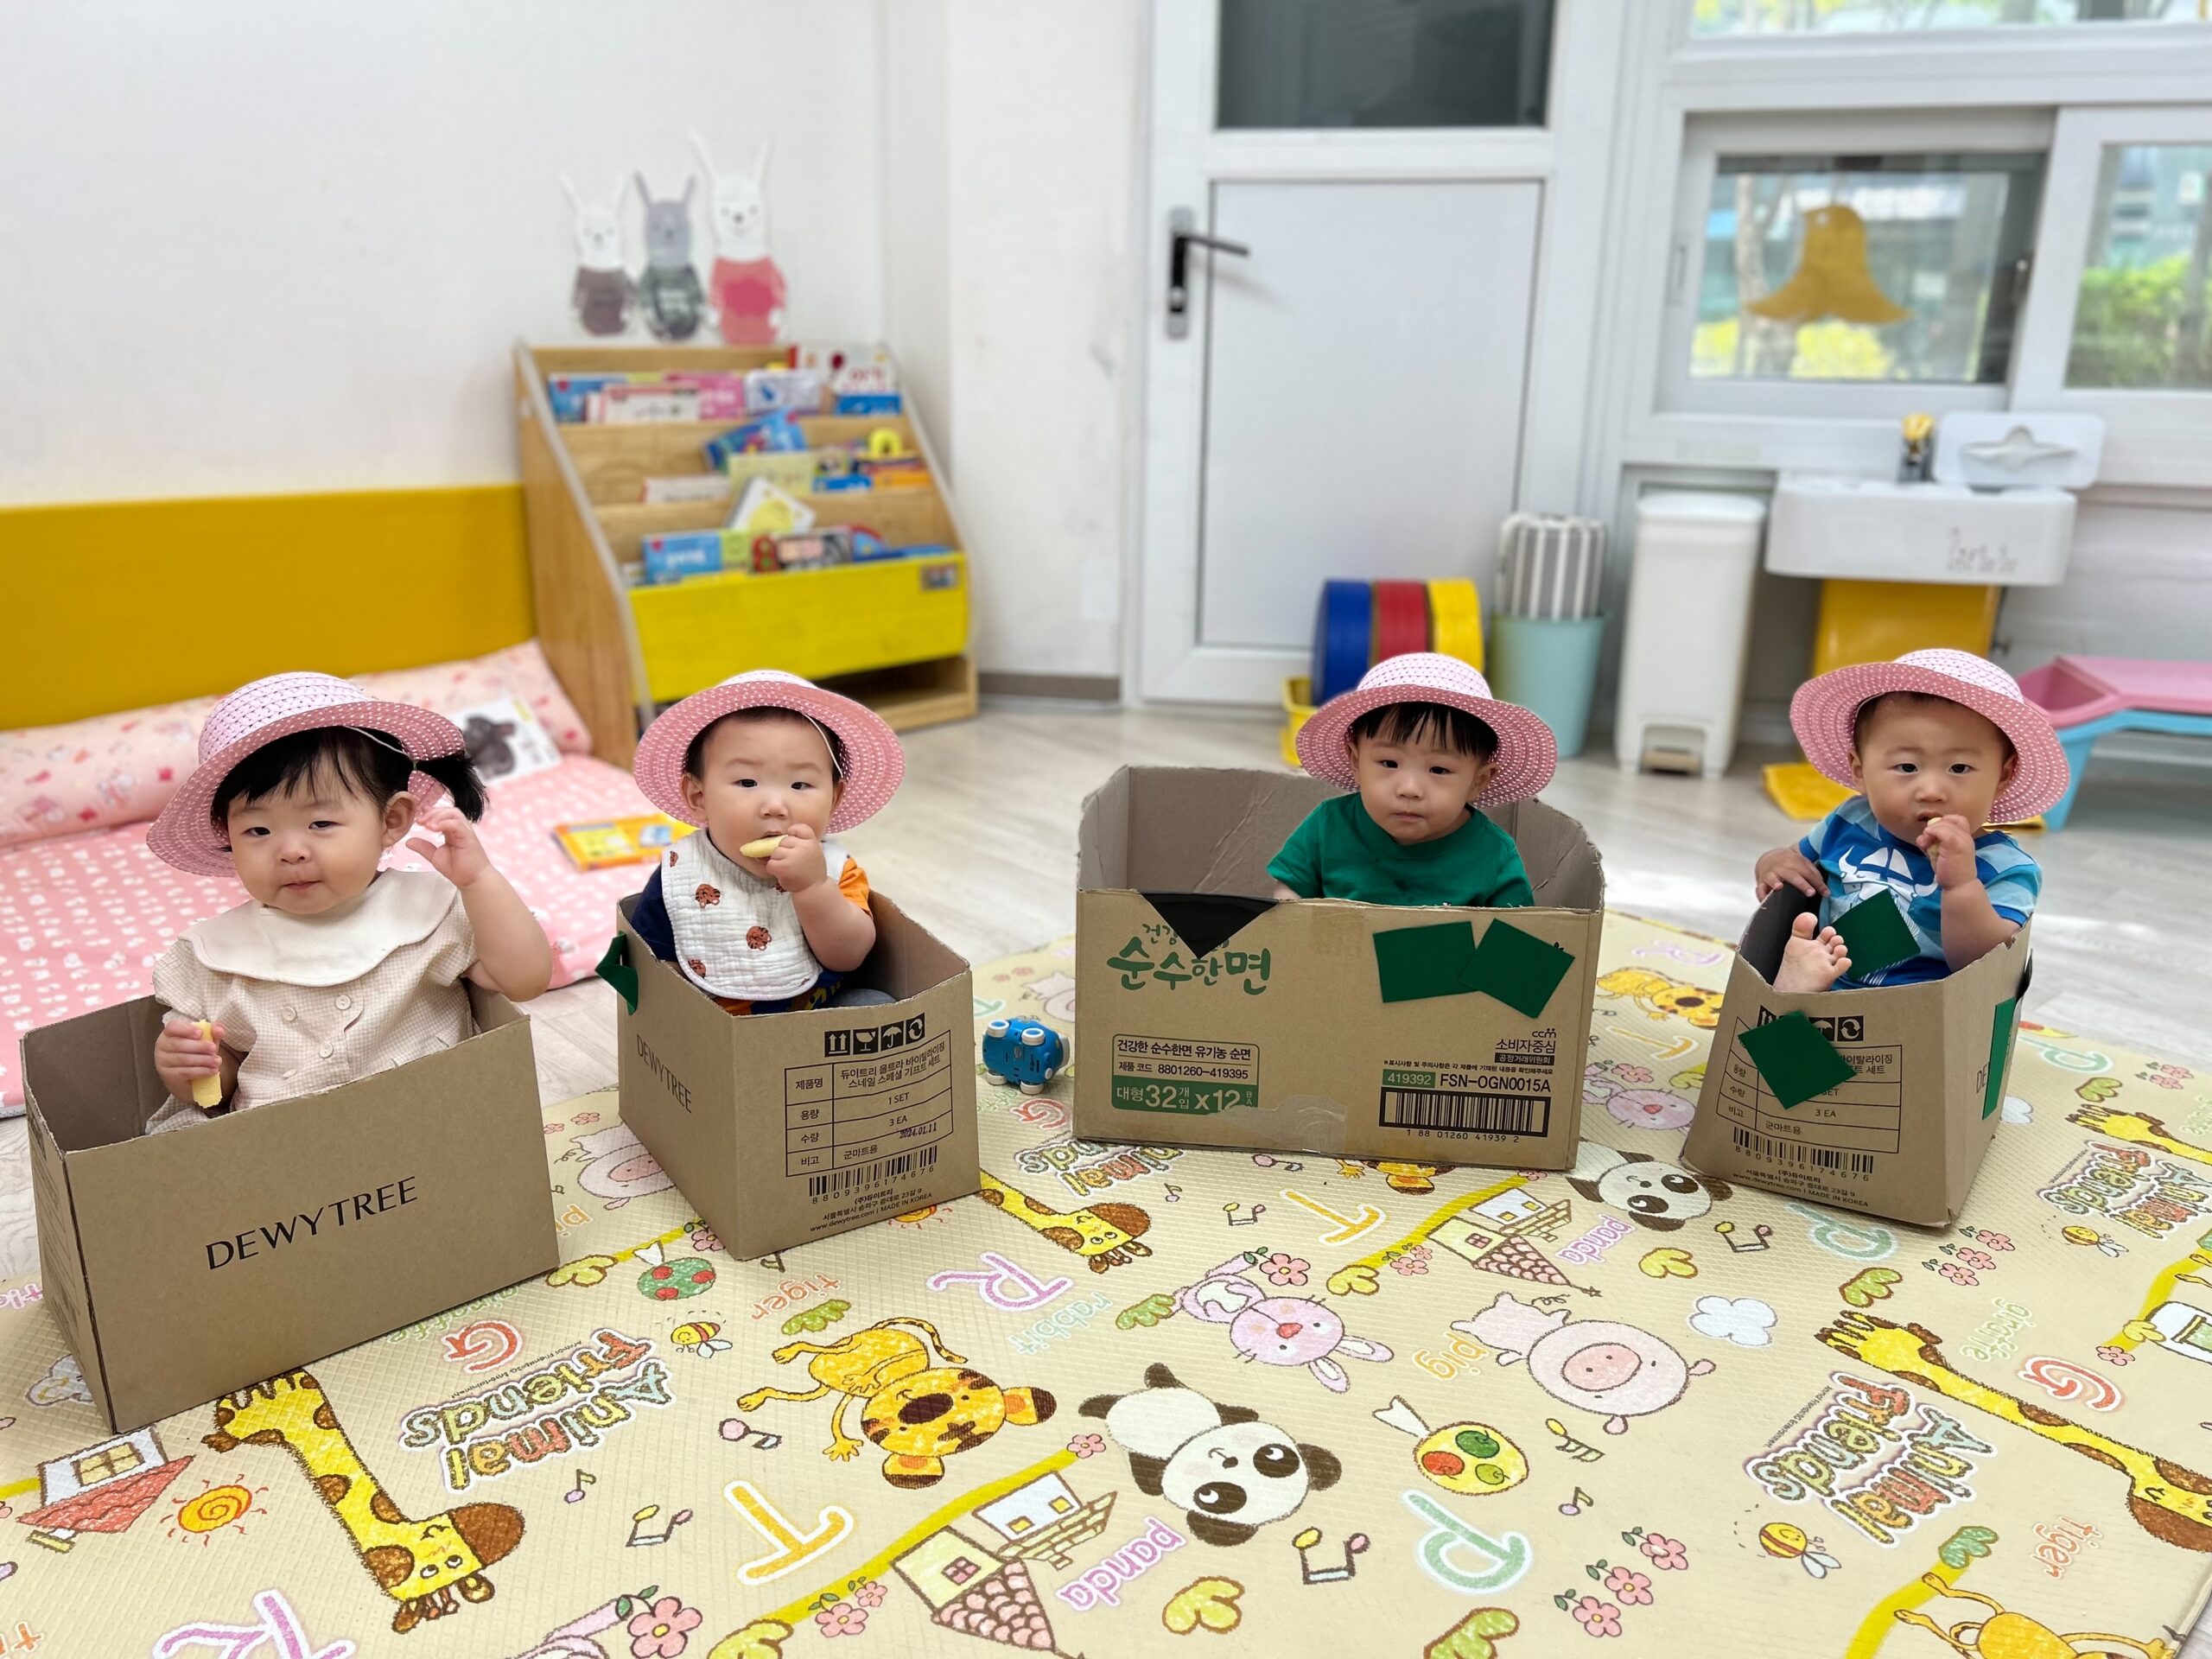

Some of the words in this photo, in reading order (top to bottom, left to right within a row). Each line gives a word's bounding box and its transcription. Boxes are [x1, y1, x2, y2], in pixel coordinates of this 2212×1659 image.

[1107, 936, 1271, 995] 순수한면
[1117, 1039, 1148, 1053] 건강한
[1151, 1042, 1192, 1058] 순수한면
[1195, 1046, 1227, 1059] 유기농
[1230, 1048, 1250, 1062] 순면
[1495, 1039, 1555, 1053] 소비자중심
[1498, 1055, 1551, 1065] 공정거래위원회
[637, 1033, 692, 1114] DEWYTREE
[795, 1077, 823, 1090] 제품명
[841, 1066, 877, 1080] 듀이트리
[849, 1077, 876, 1089] 스네일
[877, 1070, 903, 1084] 스페셜
[904, 1061, 927, 1077] 기프트
[927, 1054, 941, 1067] 세트
[1119, 1061, 1135, 1071] 제품
[1136, 1063, 1153, 1072] 코드
[1158, 1064, 1248, 1079] 8801260-419395
[1388, 1072, 1432, 1085] 419392
[1440, 1073, 1551, 1092] FSN-OGN0015A
[1729, 1085, 1745, 1098] 수량
[1733, 1064, 1746, 1077] 용량
[1866, 1065, 1886, 1075] 세트
[800, 1109, 820, 1121] 용량
[888, 1096, 893, 1105] 1
[893, 1092, 910, 1103] SET
[1013, 1098, 1066, 1128] G
[1728, 1105, 1744, 1118] 비고
[800, 1132, 820, 1144] 수량
[889, 1118, 894, 1127] 3
[896, 1115, 908, 1125] EA
[899, 1122, 938, 1139] 2024.01.11
[1766, 1120, 1802, 1135] 군마트용
[801, 1156, 819, 1166] 비고
[843, 1145, 879, 1160] 군마트용
[1060, 1145, 1184, 1196] nimal
[1808, 1189, 1830, 1199] MADE
[1842, 1197, 1869, 1208] KOREA
[2044, 1143, 2151, 1214] Friends
[206, 1176, 417, 1270] DEWYTREE
[810, 1211, 874, 1232] www.dewytree.com
[880, 1201, 900, 1212] MADE
[910, 1192, 932, 1203] KOREA
[1285, 1190, 1382, 1243] T
[1787, 1203, 1892, 1259] P
[1558, 1215, 1634, 1264] panda
[750, 1273, 840, 1322] tiger
[931, 1253, 1070, 1309] R
[1011, 1293, 1113, 1354] rabbit
[1961, 1298, 2035, 1361] giraffe
[443, 1320, 520, 1372] G
[1414, 1333, 1488, 1380] pig
[404, 1332, 652, 1447] Friends
[2022, 1358, 2117, 1410] G
[447, 1362, 672, 1491] Animal
[1753, 1375, 1911, 1502] Friends
[1830, 1406, 1993, 1545] Animal
[730, 1484, 849, 1580] T
[1407, 1491, 1529, 1589] P
[2033, 1516, 2102, 1579] tiger
[1059, 1517, 1182, 1606] panda
